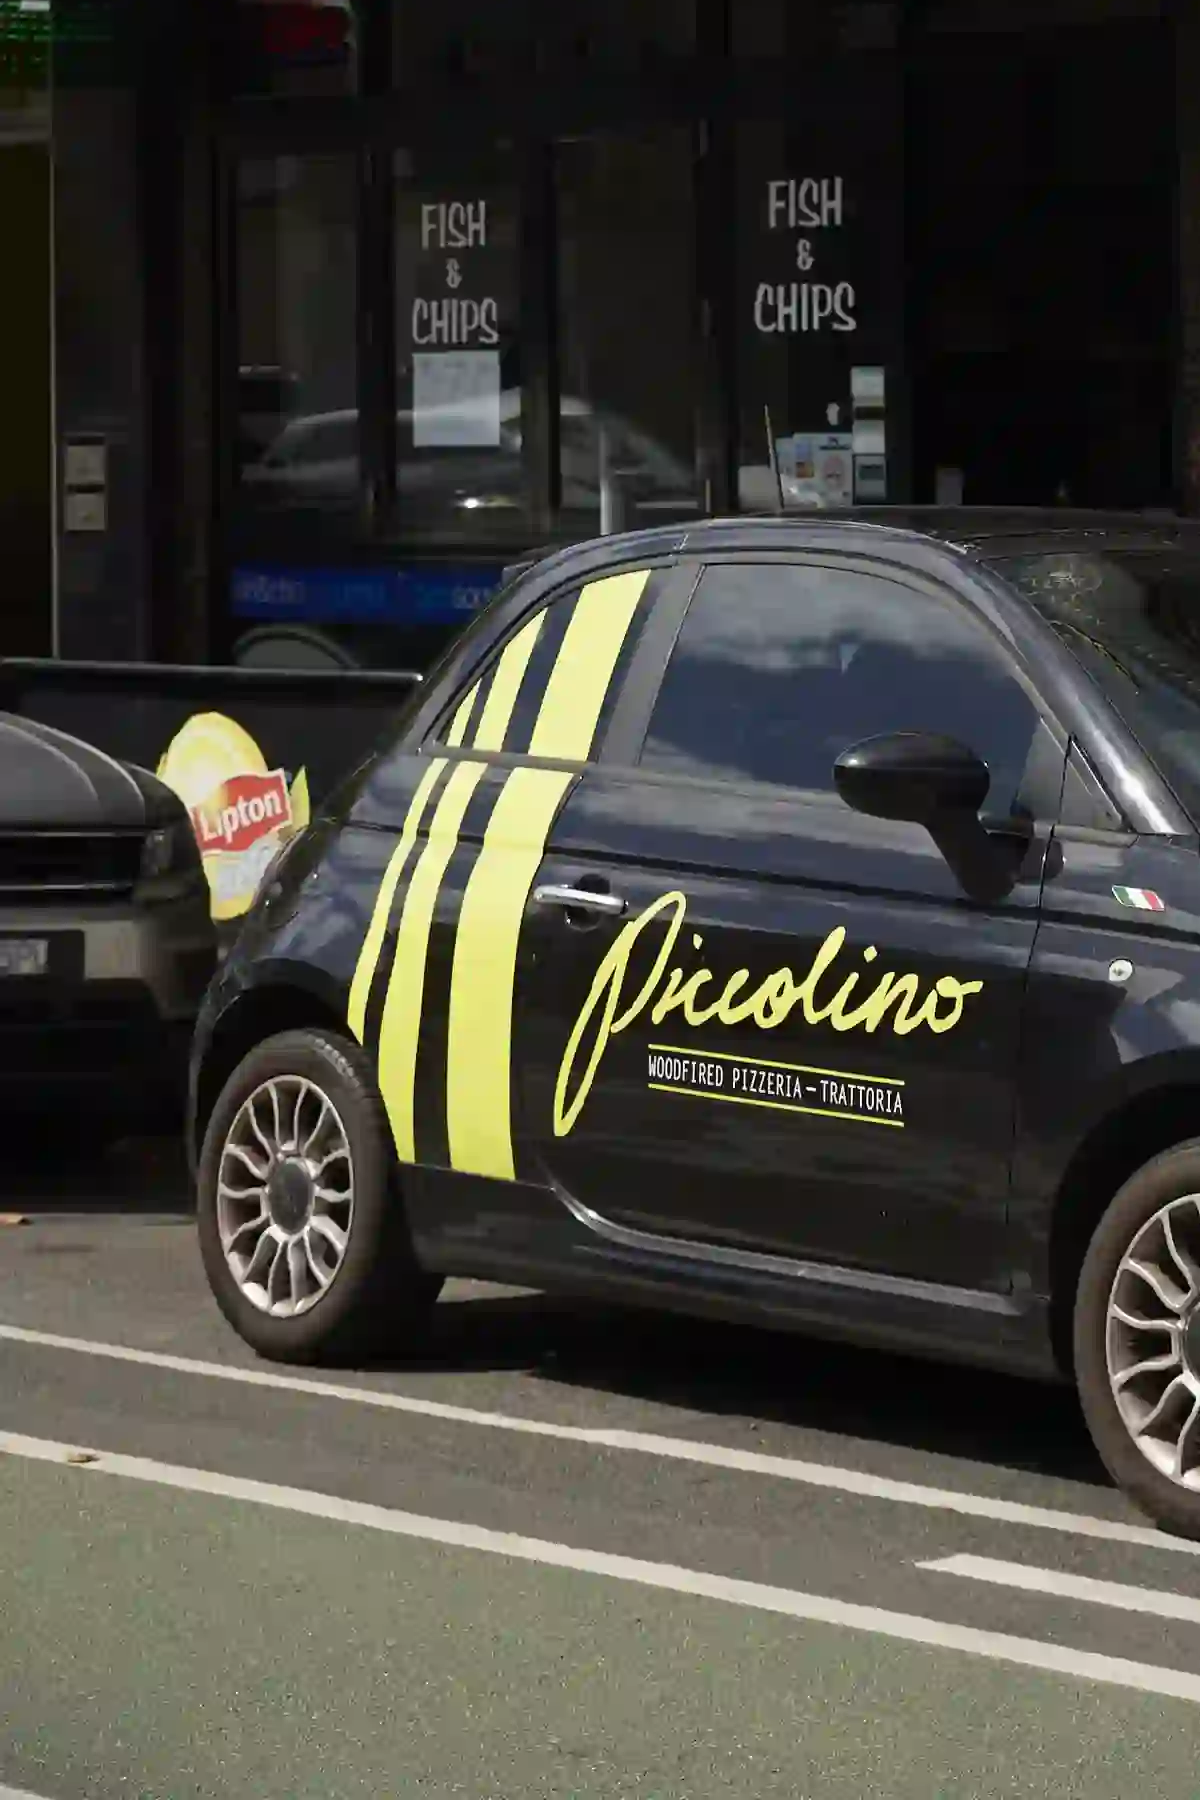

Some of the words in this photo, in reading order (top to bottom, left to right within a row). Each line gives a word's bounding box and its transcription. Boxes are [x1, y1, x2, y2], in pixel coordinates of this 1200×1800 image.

[420, 200, 487, 250] FISH
[766, 175, 843, 229] FISH
[445, 257, 463, 289] &
[796, 237, 816, 271] &
[411, 297, 500, 345] CHIPS
[753, 280, 857, 334] CHIPS
[201, 789, 283, 845] Lipton
[553, 891, 984, 1138] Piccolino
[648, 1055, 724, 1088] WOODFIRED
[732, 1067, 802, 1099] PIZZERIA
[819, 1079, 904, 1115] TRATTORIA
